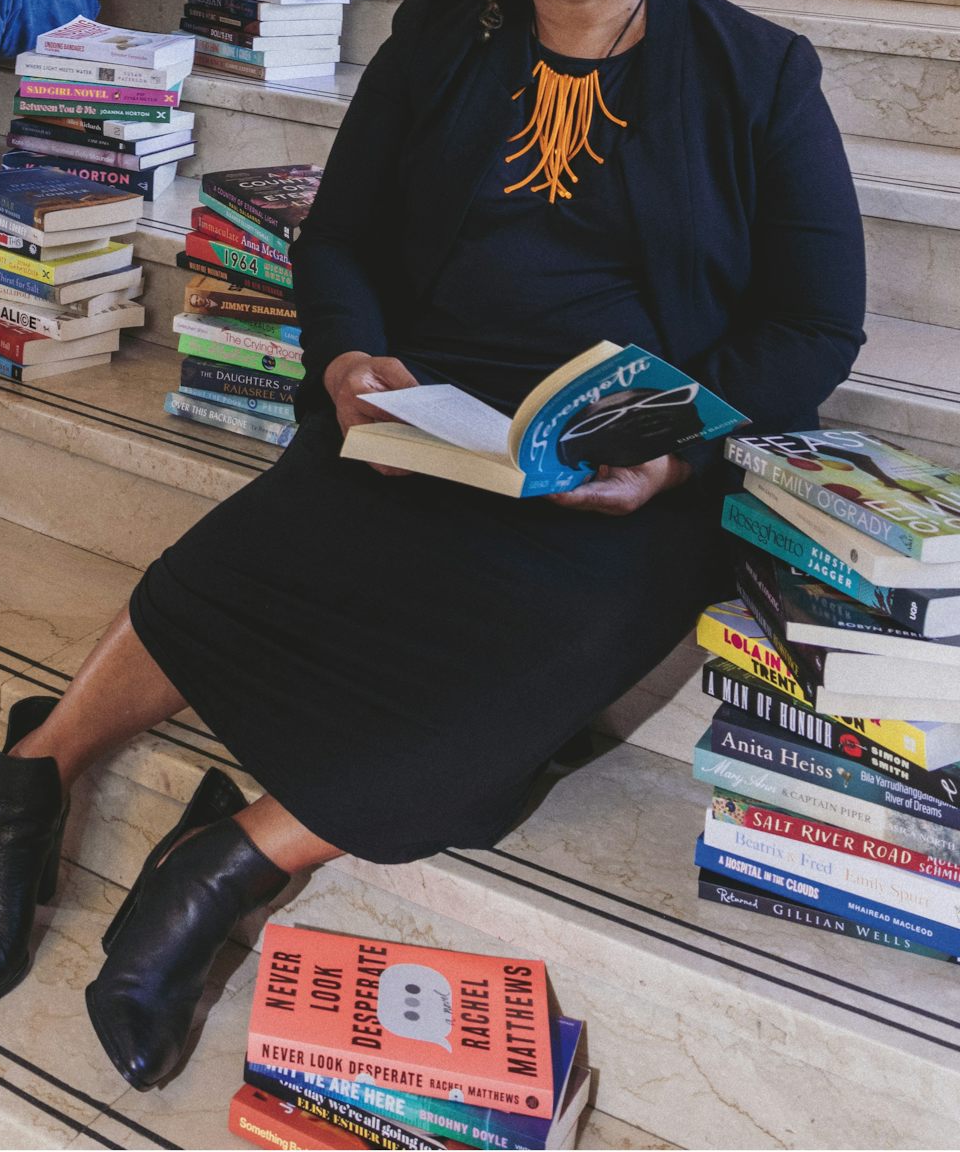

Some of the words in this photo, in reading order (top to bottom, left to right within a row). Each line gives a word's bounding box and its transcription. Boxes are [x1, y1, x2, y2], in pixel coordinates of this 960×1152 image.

[19, 101, 58, 112] Between
[26, 86, 47, 94] SAD
[47, 86, 72, 96] GIRL
[75, 88, 108, 98] NOVEL
[198, 216, 239, 243] Immaculate
[241, 235, 260, 252] Anna
[223, 249, 258, 276] 1964
[26, 282, 39, 294] Salt
[220, 301, 251, 313] JIMMY
[252, 305, 297, 318] SHARMAN
[224, 332, 241, 346] The
[243, 335, 275, 355] Crying
[216, 370, 280, 389] DAUGHTERS
[171, 399, 189, 412] OVER
[192, 405, 208, 417] THIS
[208, 410, 247, 428] BACKBONE
[530, 357, 651, 473] Serengotti
[677, 432, 706, 445] EUGEN
[707, 418, 739, 436] BACON
[738, 430, 882, 455] FEAST
[728, 444, 768, 476] FEAST
[772, 467, 813, 499] EMILY
[817, 491, 892, 541] O'GRADY
[730, 504, 805, 558] Roseghetto
[811, 547, 854, 575] KIRSTY
[807, 559, 853, 589] JAGGER
[837, 621, 883, 632] ROBYN
[910, 601, 918, 621] UQP
[724, 628, 762, 661] LOLA
[765, 650, 782, 671] IN
[751, 659, 796, 694] TRENT
[708, 671, 715, 696] A
[722, 676, 749, 710] MAN
[757, 692, 772, 721] OF
[780, 701, 832, 749] HONOUR
[721, 731, 774, 762] Anita
[780, 748, 833, 780] Heiss
[870, 746, 910, 770] SIMON
[871, 757, 909, 780] SMITH
[840, 805, 873, 825] PIPER
[885, 791, 904, 807] River
[904, 797, 913, 808] of
[913, 800, 942, 819] Dreams
[753, 811, 796, 835] SALT
[801, 824, 855, 851] RIVER
[863, 839, 913, 865] ROAD
[725, 856, 763, 881] HOSPITAL
[763, 870, 771, 881] IN
[771, 873, 784, 887] THE
[786, 878, 820, 900] CLOUDS
[800, 852, 833, 876] Fred
[845, 868, 886, 895] Emily
[717, 887, 759, 910] Returned
[773, 904, 845, 932] GILLIAN
[856, 925, 912, 949] WELLS
[848, 902, 890, 922] MHAIREAD
[892, 918, 934, 938] MACLEOD
[265, 951, 302, 1012] NEVER
[310, 964, 344, 1013] LOOK
[351, 944, 388, 1050] DESPERATE
[461, 979, 491, 1051] RACHEL
[504, 964, 539, 1078] MATTHEWS
[262, 1043, 305, 1066] NEVER
[310, 1053, 343, 1073] LOOK
[349, 1060, 423, 1088] DESPERATE
[468, 1086, 520, 1105] MATTHEWS
[297, 1097, 330, 1122] ELISE
[332, 1114, 380, 1144] ESTHER
[328, 1079, 360, 1100] ARE
[363, 1087, 406, 1116] HERE
[419, 1109, 470, 1135] BRIOHNY
[472, 1127, 509, 1149] DOYLE
[363, 1113, 380, 1130] all
[381, 1124, 420, 1149] going
